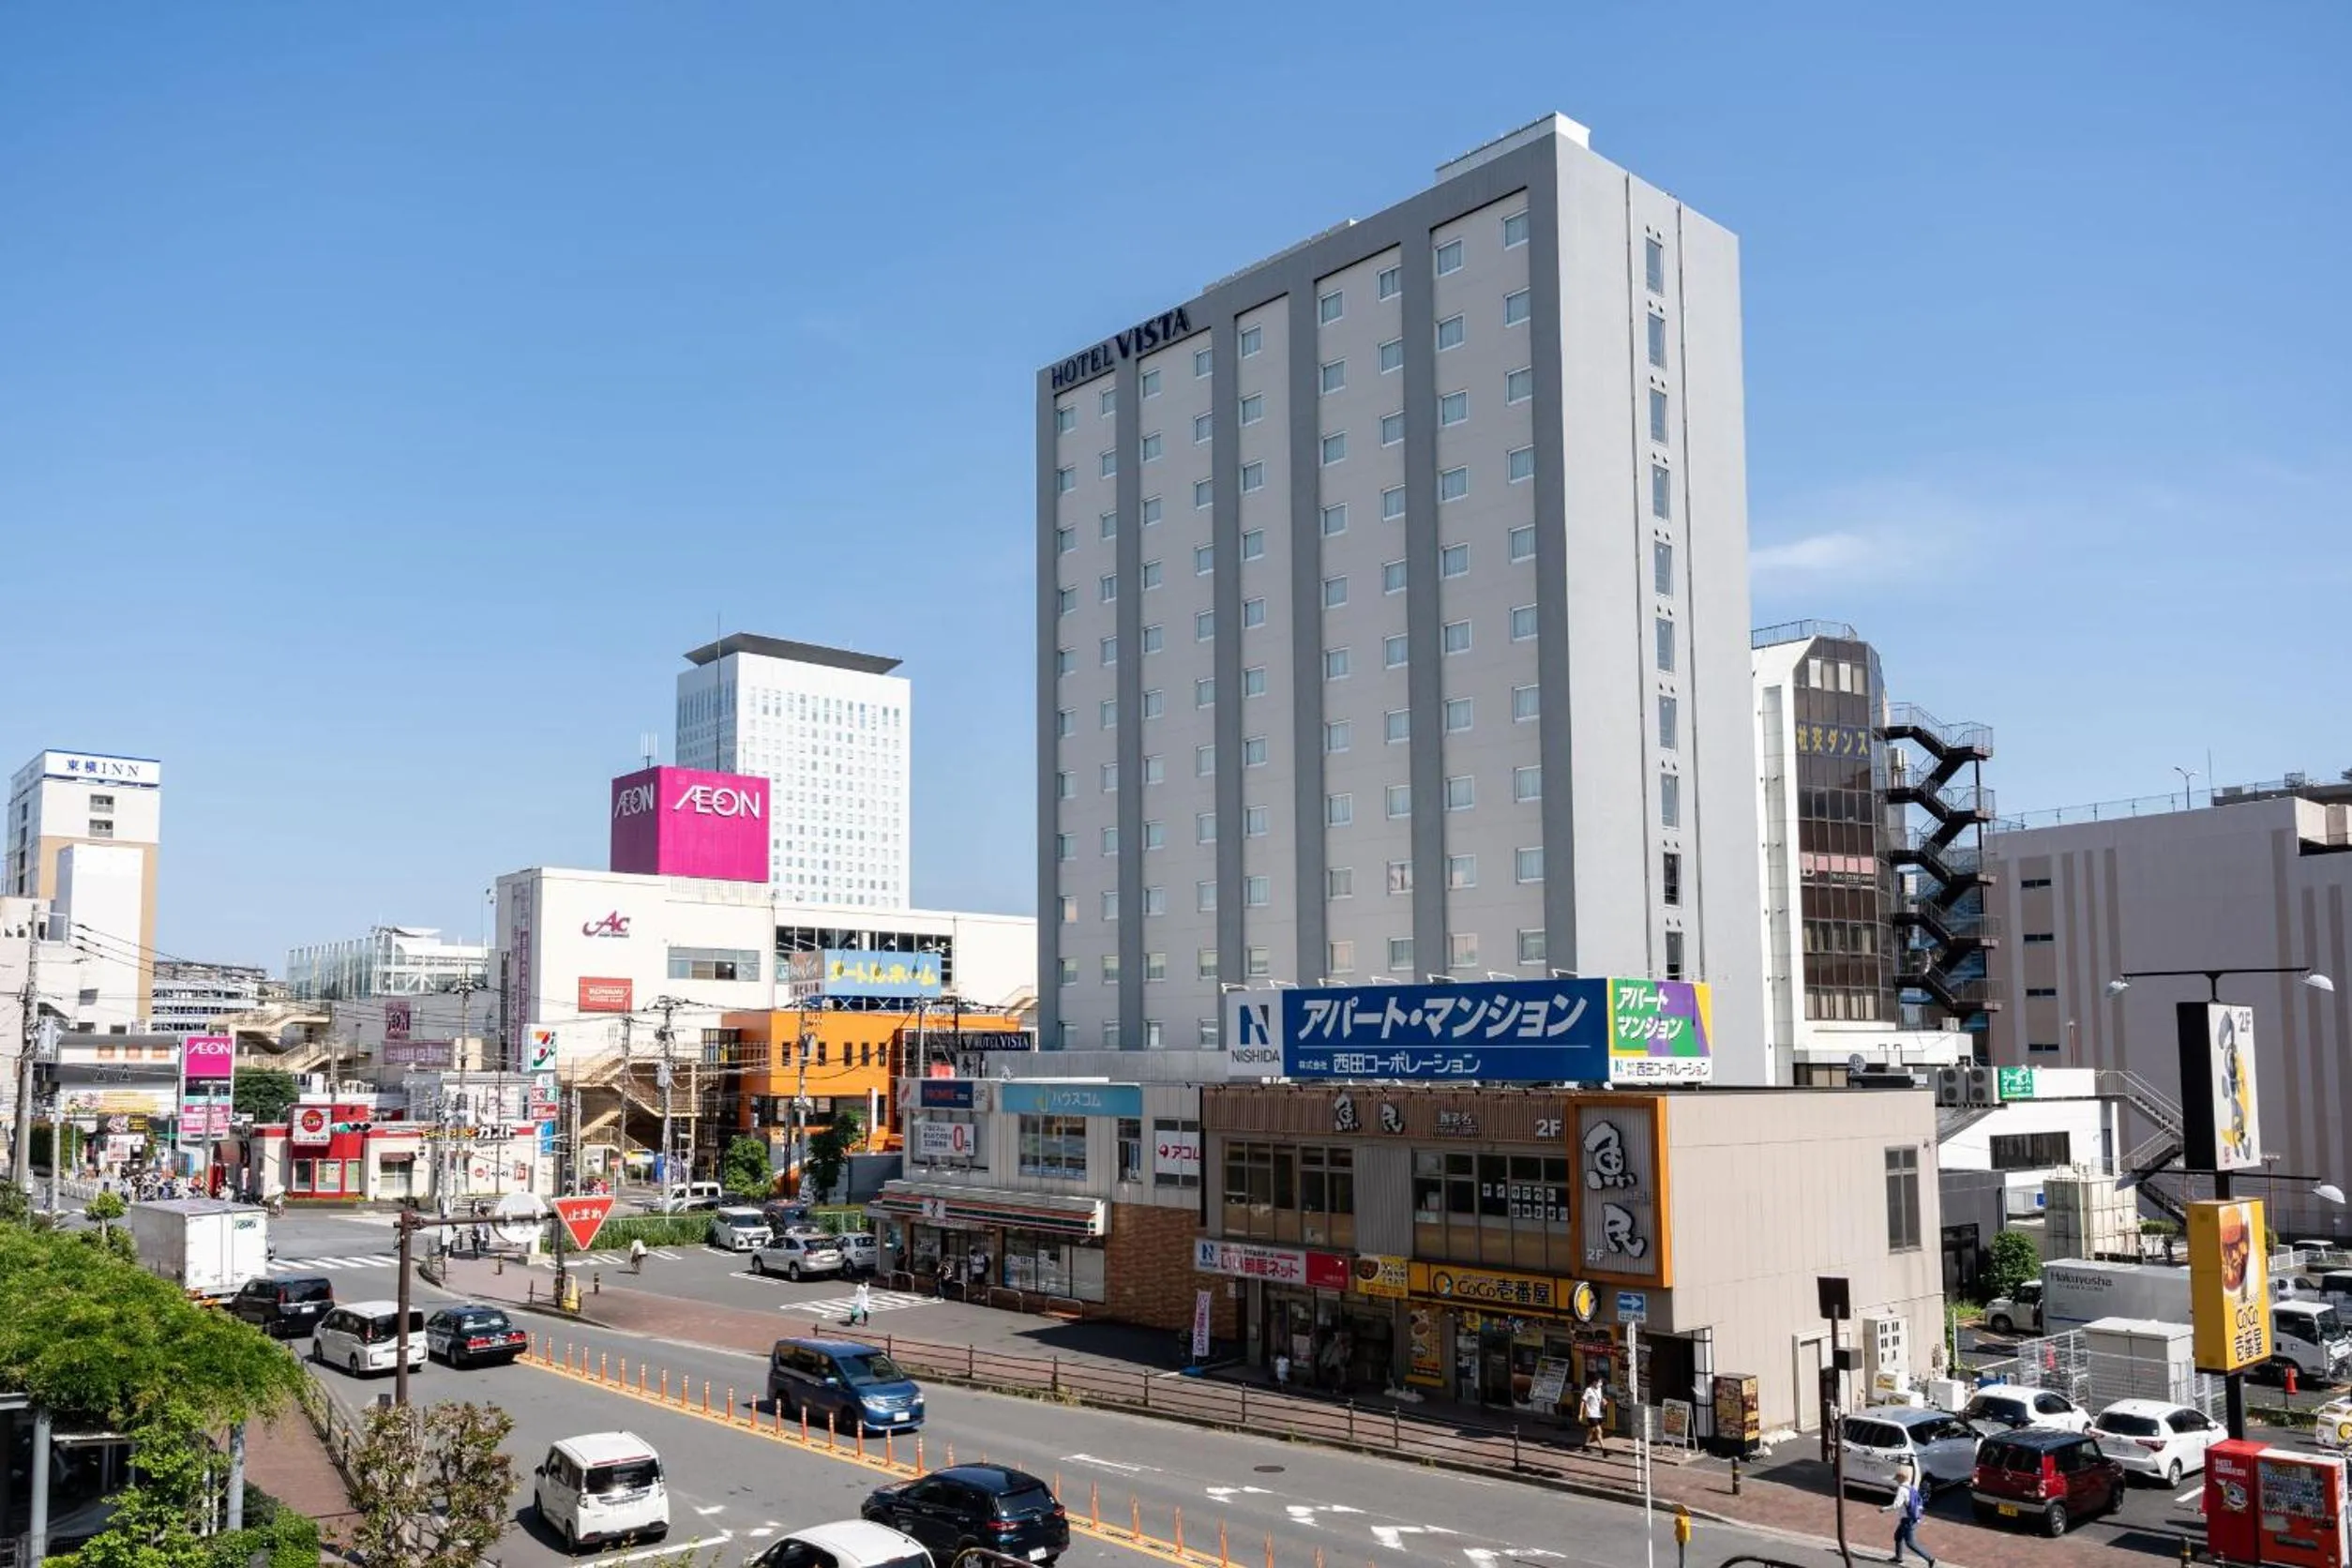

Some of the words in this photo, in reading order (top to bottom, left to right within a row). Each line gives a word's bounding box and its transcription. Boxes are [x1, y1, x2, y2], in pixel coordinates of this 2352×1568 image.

[1051, 344, 1114, 389] HOTEL
[1116, 307, 1190, 359] VISTA
[1298, 995, 1588, 1040] アパート・マンション
[1618, 1016, 1683, 1040] マンション
[998, 1034, 1029, 1048] VISTA
[1231, 1049, 1280, 1063] NISHIDA
[1334, 1050, 1481, 1074] 西田コーポレーション
[1051, 1092, 1102, 1107] ハウスコム
[1535, 1119, 1562, 1138] 2F
[567, 1207, 602, 1222] 止まれ
[1586, 1248, 1605, 1261] 2F
